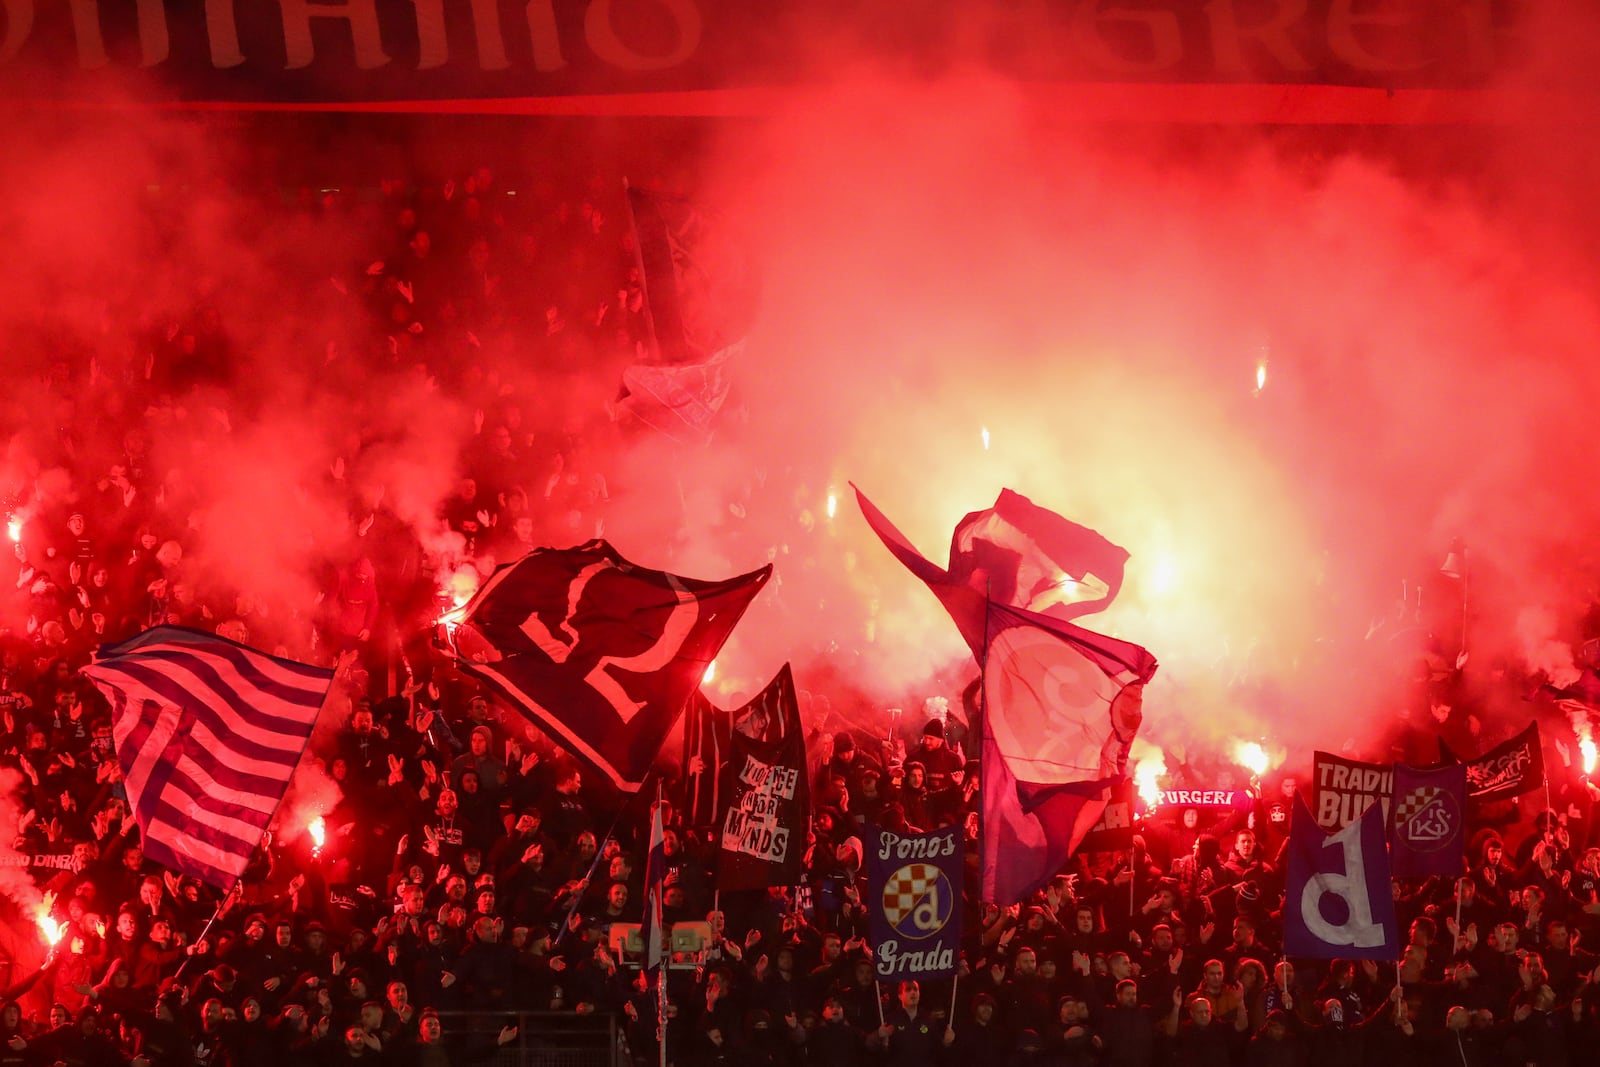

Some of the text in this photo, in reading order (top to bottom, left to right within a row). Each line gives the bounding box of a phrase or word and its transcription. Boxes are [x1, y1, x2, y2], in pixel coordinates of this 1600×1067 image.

[744, 760, 796, 791] VIOENCE
[1157, 790, 1235, 806] PURGERI
[878, 831, 956, 861] Ponos
[877, 939, 954, 975] Grada
